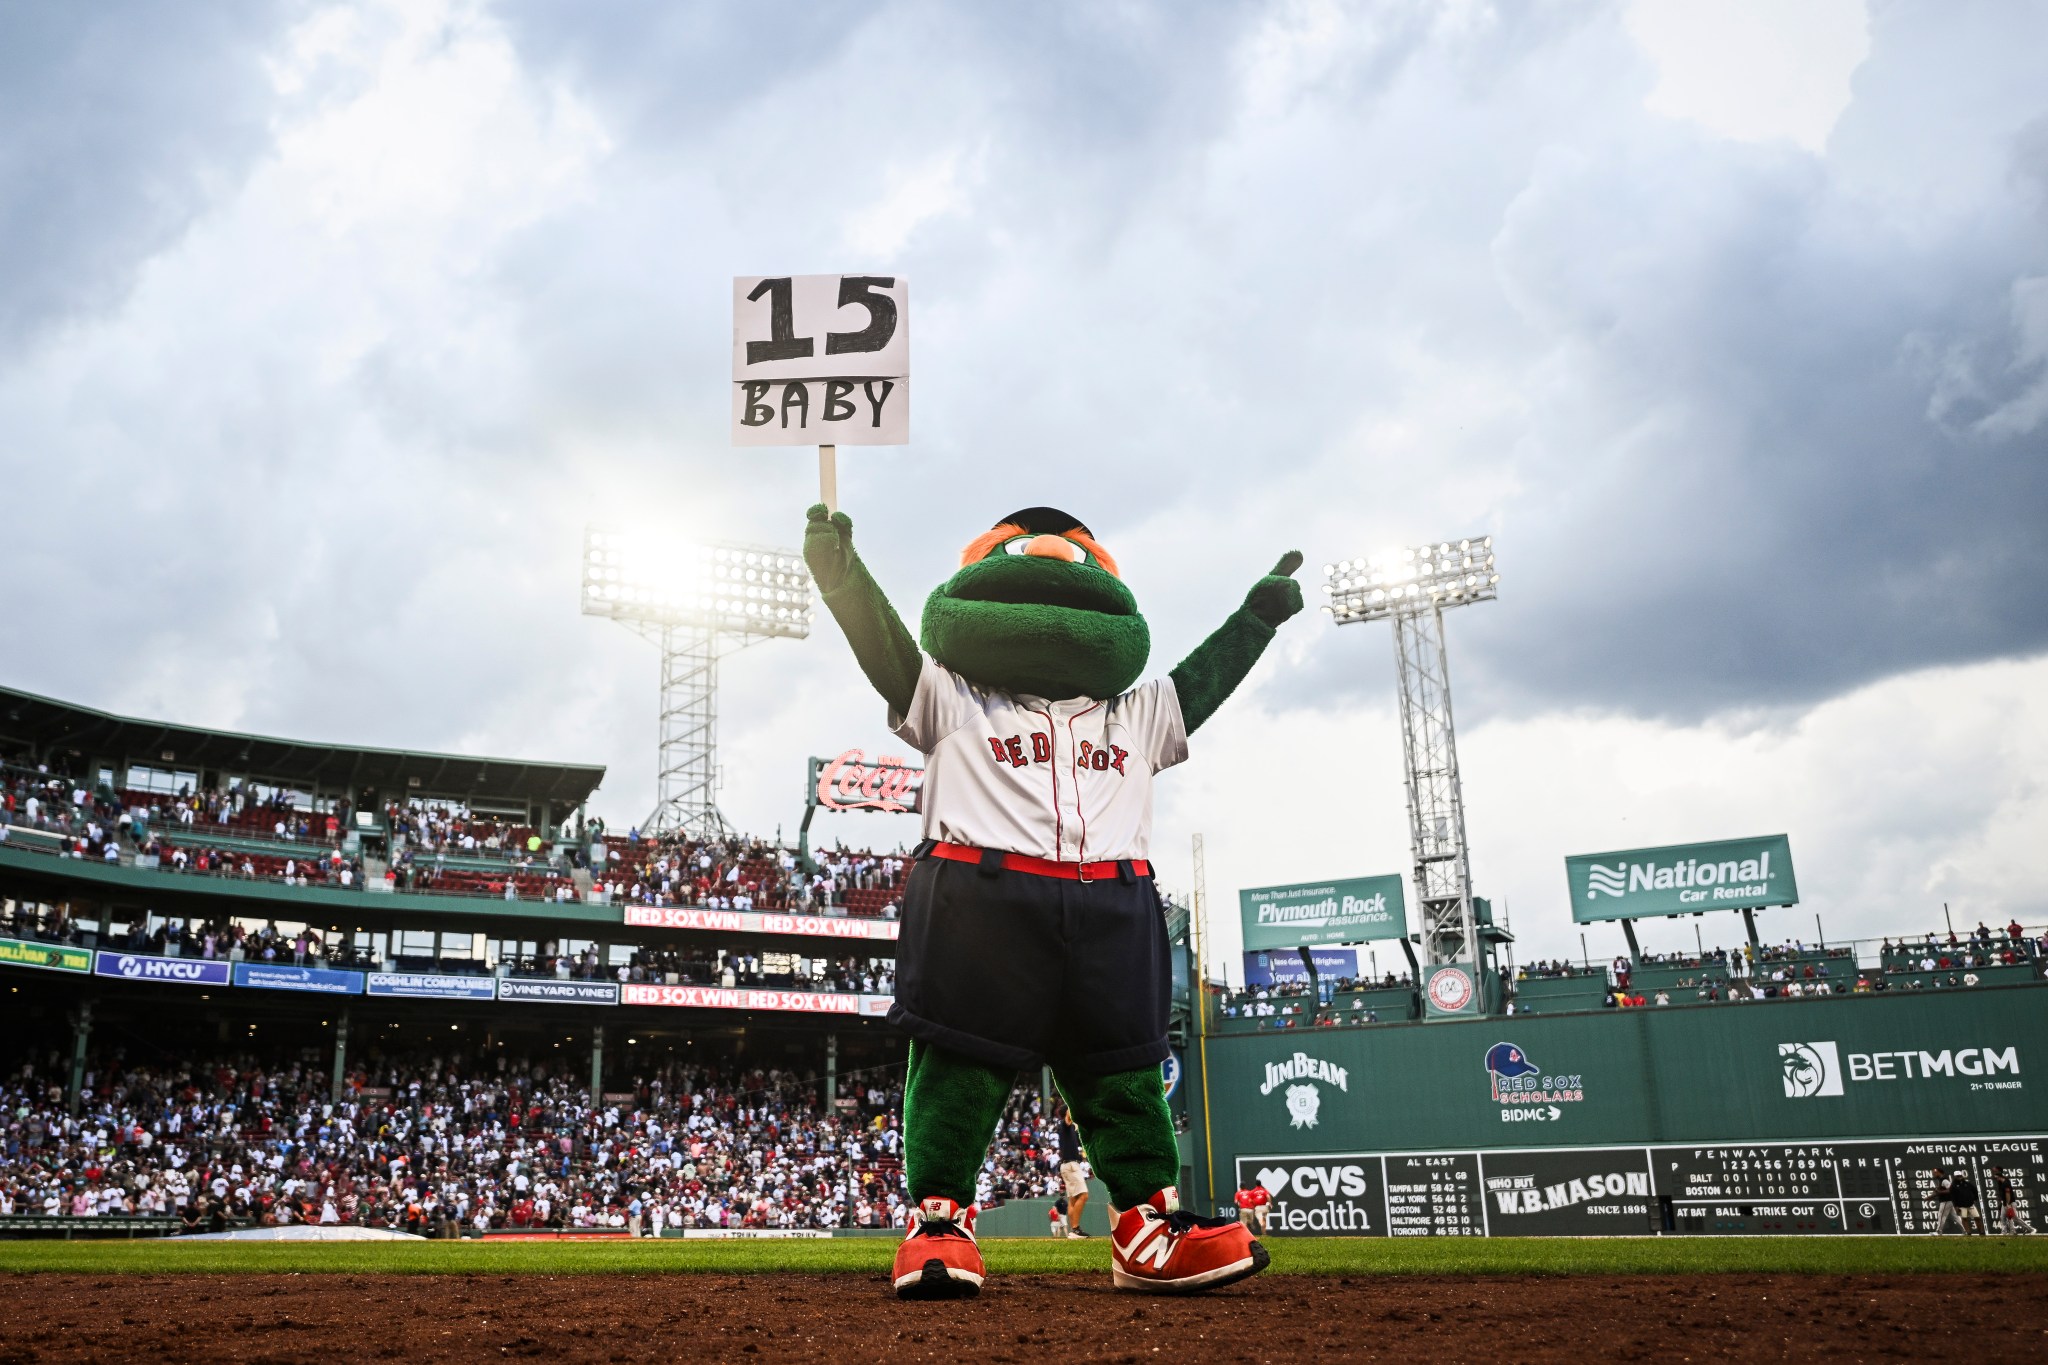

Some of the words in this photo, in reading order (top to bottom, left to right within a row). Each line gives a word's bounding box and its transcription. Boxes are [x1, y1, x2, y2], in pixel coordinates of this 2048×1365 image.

[747, 275, 898, 366] 15
[740, 380, 895, 429] BABY
[987, 732, 1051, 768] RED
[1077, 740, 1129, 777] SOX
[1251, 893, 1269, 902] More
[1270, 890, 1287, 900] Than
[1287, 889, 1301, 899] Just
[1679, 889, 1708, 903] Car
[1713, 882, 1768, 900] Rental
[1258, 897, 1338, 923] Plymouth
[1342, 892, 1386, 915] Rock
[630, 907, 662, 926] RED
[664, 909, 699, 927] SOX
[700, 911, 740, 929] WIN
[763, 916, 792, 932] RED
[795, 917, 829, 935] SOX
[830, 919, 868, 936] WIN
[1315, 957, 1345, 966] Brigham
[145, 961, 201, 979] HYCU
[371, 976, 423, 987] COGHLIN
[423, 977, 493, 990] COMPANIES
[513, 984, 576, 996] VINEYARD
[577, 987, 615, 999] VINES
[627, 986, 663, 1003] RED
[664, 988, 699, 1005] SOX
[700, 989, 739, 1006] WIN
[748, 992, 782, 1009] RED
[783, 993, 816, 1010] SOX
[818, 994, 856, 1011] WIN
[1847, 1046, 2020, 1081] BETMGM
[1260, 1059, 1295, 1096] JIM
[1293, 1052, 1349, 1093] BEAM
[1499, 1077, 1537, 1091] RED
[1542, 1075, 1583, 1090] SOX
[1970, 1083, 1983, 1091] 21+
[1983, 1082, 1994, 1090] TO
[1995, 1081, 2022, 1090] WAGER
[1500, 1089, 1584, 1104] SCHOLARS
[1501, 1108, 1546, 1122] BIDMC
[1694, 1149, 1769, 1160] FENWAY
[1784, 1147, 1834, 1157] PARK
[1906, 1144, 1977, 1154] AMERICAN
[1984, 1142, 2039, 1152] LEAGUE
[1407, 1158, 1421, 1167] AL
[1425, 1157, 1455, 1166] EAST
[1671, 1162, 1679, 1172] P
[1722, 1160, 1727, 1170] 1
[1731, 1160, 1738, 1170] 2
[1741, 1160, 1748, 1170] 3
[1754, 1160, 1761, 1170] 4
[1764, 1160, 1772, 1170] 5
[1774, 1160, 1781, 1170] 6
[1787, 1160, 1794, 1169] 7
[1798, 1160, 1805, 1169] 8
[1808, 1160, 1815, 1169] 9
[1820, 1159, 1832, 1169] 10
[1842, 1158, 1850, 1168] R
[1858, 1158, 1866, 1167] H
[1873, 1158, 1881, 1167] E
[1894, 1157, 1902, 1167] P
[1941, 1156, 1954, 1166] IN
[1958, 1156, 1966, 1165] R
[1981, 1155, 1989, 1165] P
[2031, 1154, 2044, 1164] IN
[1431, 1172, 1439, 1181] W
[1444, 1171, 1451, 1180] L
[1455, 1171, 1468, 1180] GB
[1689, 1173, 1713, 1183] BALT
[1723, 1173, 1729, 1182] 0
[1733, 1173, 1740, 1182] 0
[1766, 1172, 1773, 1182] 0
[1790, 1172, 1796, 1181] 0
[1800, 1172, 1807, 1181] 0
[1810, 1172, 1817, 1181] 0
[1896, 1170, 1906, 1179] 51
[1915, 1170, 1933, 1179] CIN
[1983, 1168, 1992, 1178] 18
[1291, 1165, 1367, 1198] CVS
[1389, 1184, 1412, 1193] TAMPA
[1413, 1184, 1428, 1193] BAY
[1430, 1183, 1443, 1192] 58
[1443, 1183, 1455, 1192] 42
[1487, 1178, 1512, 1190] WHO
[1514, 1177, 1534, 1189] BUT
[1897, 1180, 1908, 1189] 26
[1915, 1180, 1936, 1189] SEA
[1985, 1178, 1994, 1188] 13
[1685, 1186, 1721, 1196] BOSTON
[1725, 1186, 1732, 1195] 4
[1734, 1186, 1741, 1195] 0
[1768, 1186, 1775, 1194] 0
[1778, 1186, 1785, 1194] 0
[1792, 1185, 1799, 1194] 0
[1802, 1185, 1809, 1194] 0
[1898, 1190, 1909, 1200] 66
[1986, 1189, 1997, 1199] 22
[1389, 1195, 1406, 1204] NEW
[1407, 1195, 1427, 1203] YORK
[1431, 1194, 1443, 1203] 56
[1444, 1194, 1456, 1203] 44
[1460, 1194, 1467, 1203] 2
[1900, 1200, 1910, 1209] 67
[1921, 1200, 1937, 1209] KC
[1988, 1199, 1998, 1209] 63
[1218, 1206, 1237, 1218] 310
[1266, 1200, 1371, 1231] Health
[1390, 1205, 1421, 1214] BOSTON
[1432, 1205, 1444, 1214] 52
[1446, 1205, 1457, 1214] 48
[1461, 1205, 1468, 1213] 6
[1587, 1205, 1620, 1215] SINCE
[1622, 1204, 1648, 1214] 1898
[1677, 1208, 1689, 1217] AT
[1690, 1207, 1707, 1217] BAT
[1715, 1207, 1741, 1217] BALL
[1752, 1206, 1787, 1216] STRIKE
[1792, 1206, 1815, 1216] OUT
[1902, 1211, 1913, 1220] 23
[1990, 1210, 1999, 1219] 17
[1391, 1216, 1432, 1225] BALTIMORE
[1434, 1216, 1445, 1225] 49
[1446, 1216, 1458, 1225] 53
[1461, 1215, 1470, 1224] 10
[1904, 1221, 1915, 1230] 45
[1392, 1227, 1429, 1236] TORONTO
[1435, 1227, 1446, 1236] 46
[1447, 1227, 1459, 1236] 55
[1462, 1226, 1471, 1235] 12
